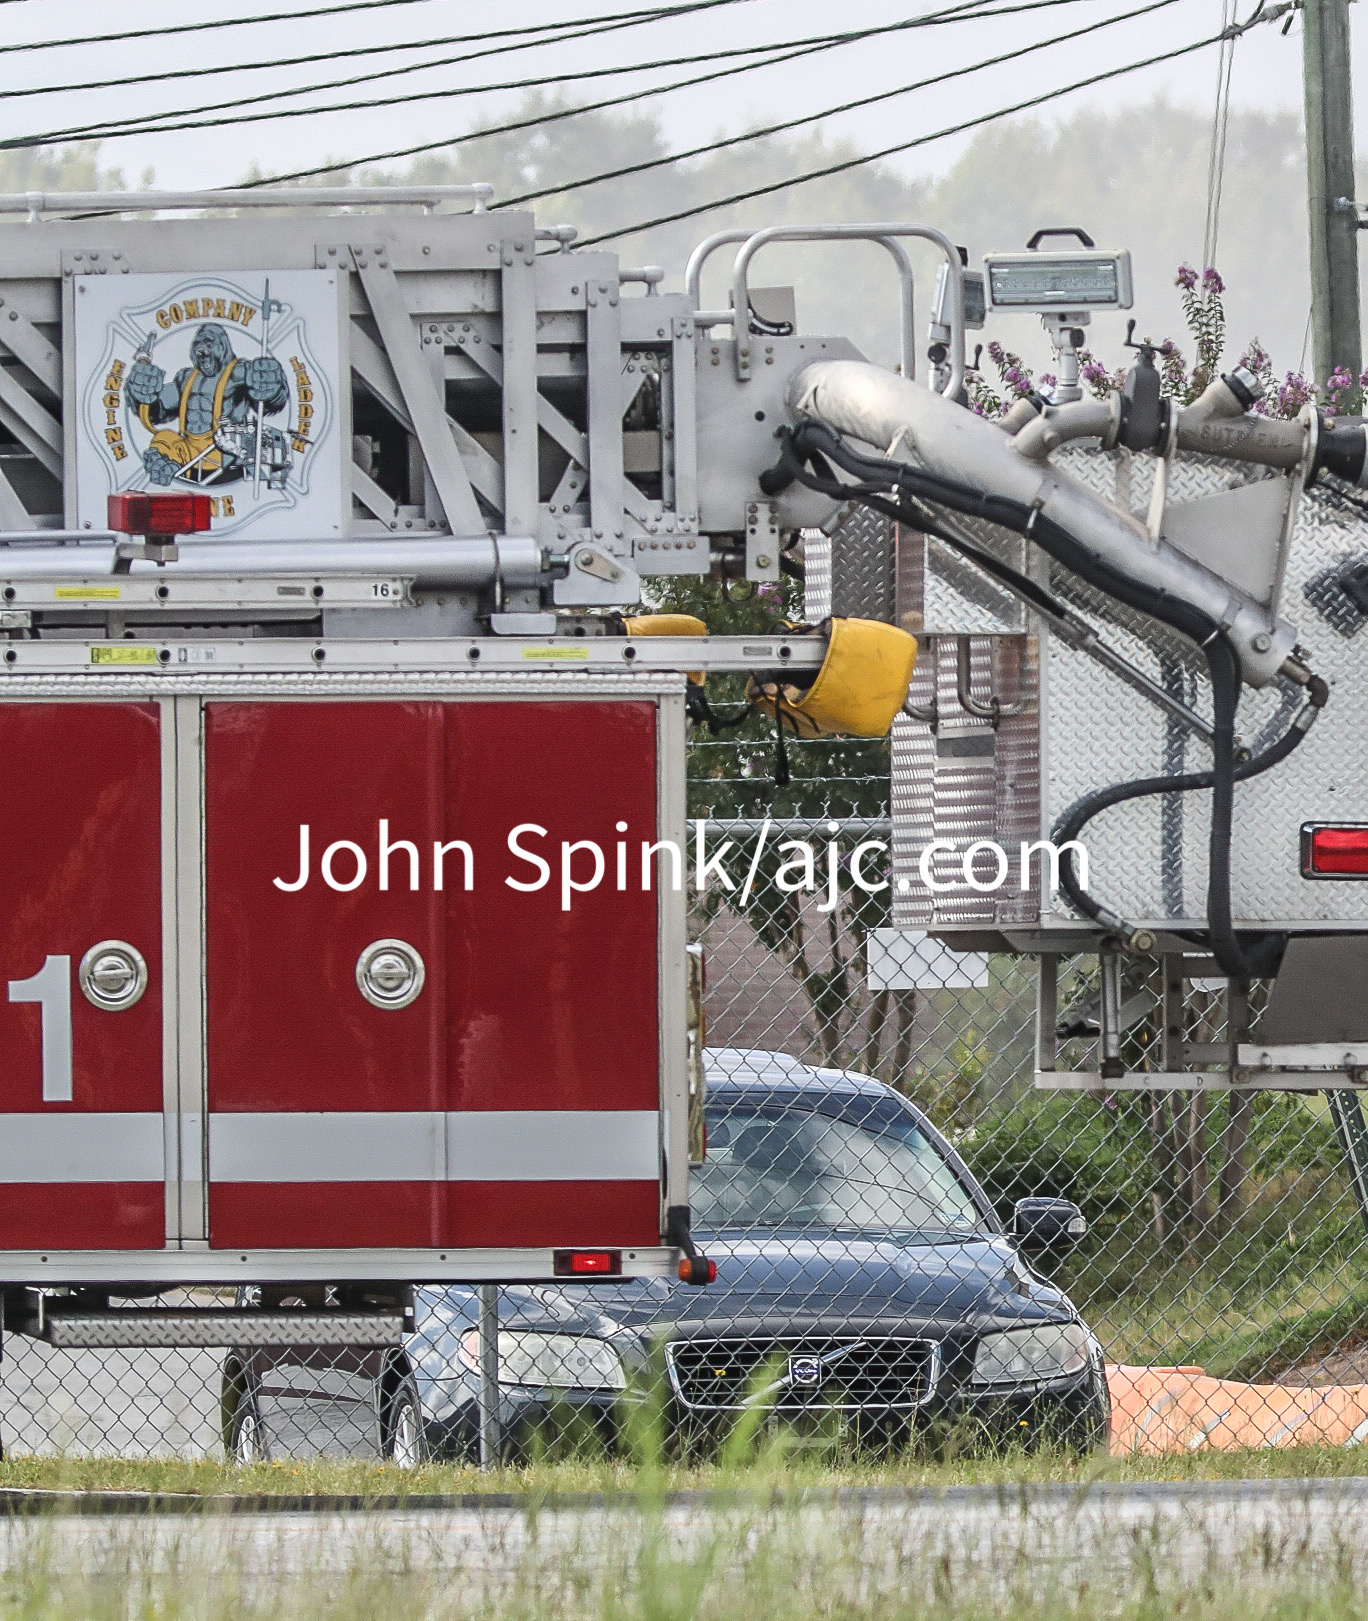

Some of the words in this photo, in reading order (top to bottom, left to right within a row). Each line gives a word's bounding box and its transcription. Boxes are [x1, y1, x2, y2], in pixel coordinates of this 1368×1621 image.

[156, 297, 256, 329] COMPANY
[102, 359, 128, 461] ENGINE
[289, 356, 314, 453] LADDER
[372, 583, 389, 597] 16
[8, 954, 72, 1102] 1
